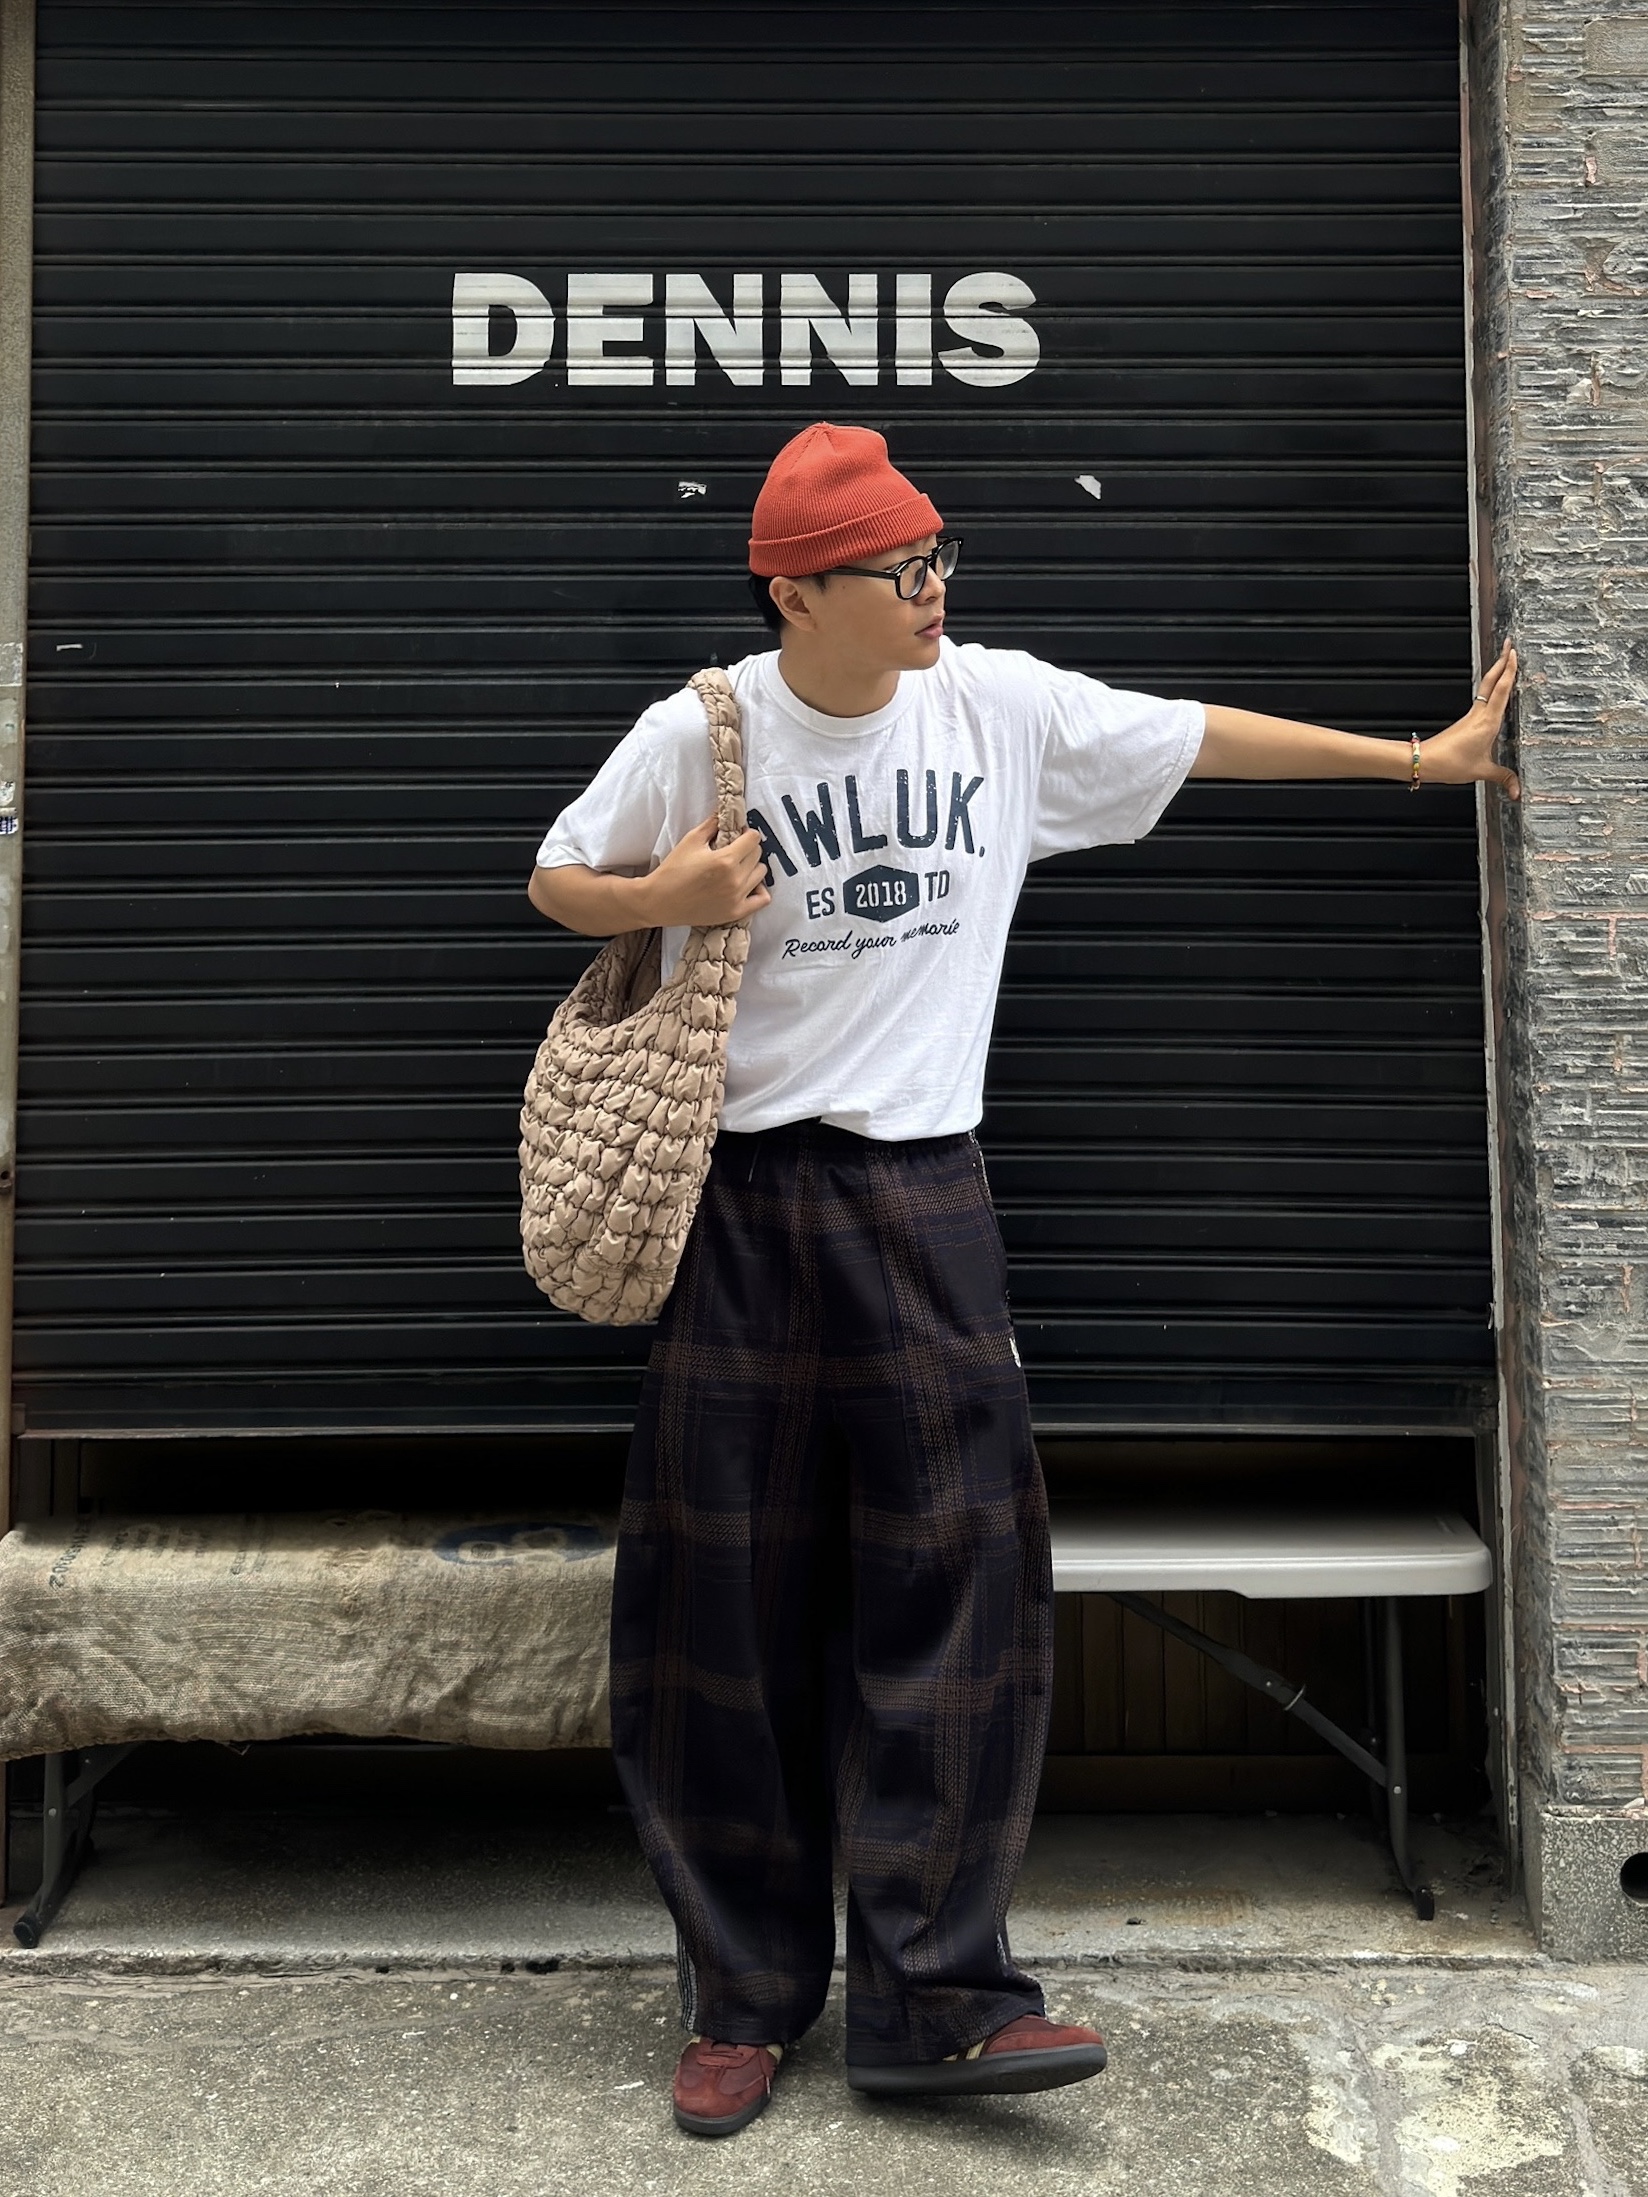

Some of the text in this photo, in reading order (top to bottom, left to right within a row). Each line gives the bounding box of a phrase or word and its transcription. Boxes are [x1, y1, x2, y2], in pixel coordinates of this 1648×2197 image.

[452, 271, 1041, 388] DENNIS
[806, 870, 950, 920] ES 2018 TD
[782, 930, 853, 960] Record
[851, 935, 897, 960] your
